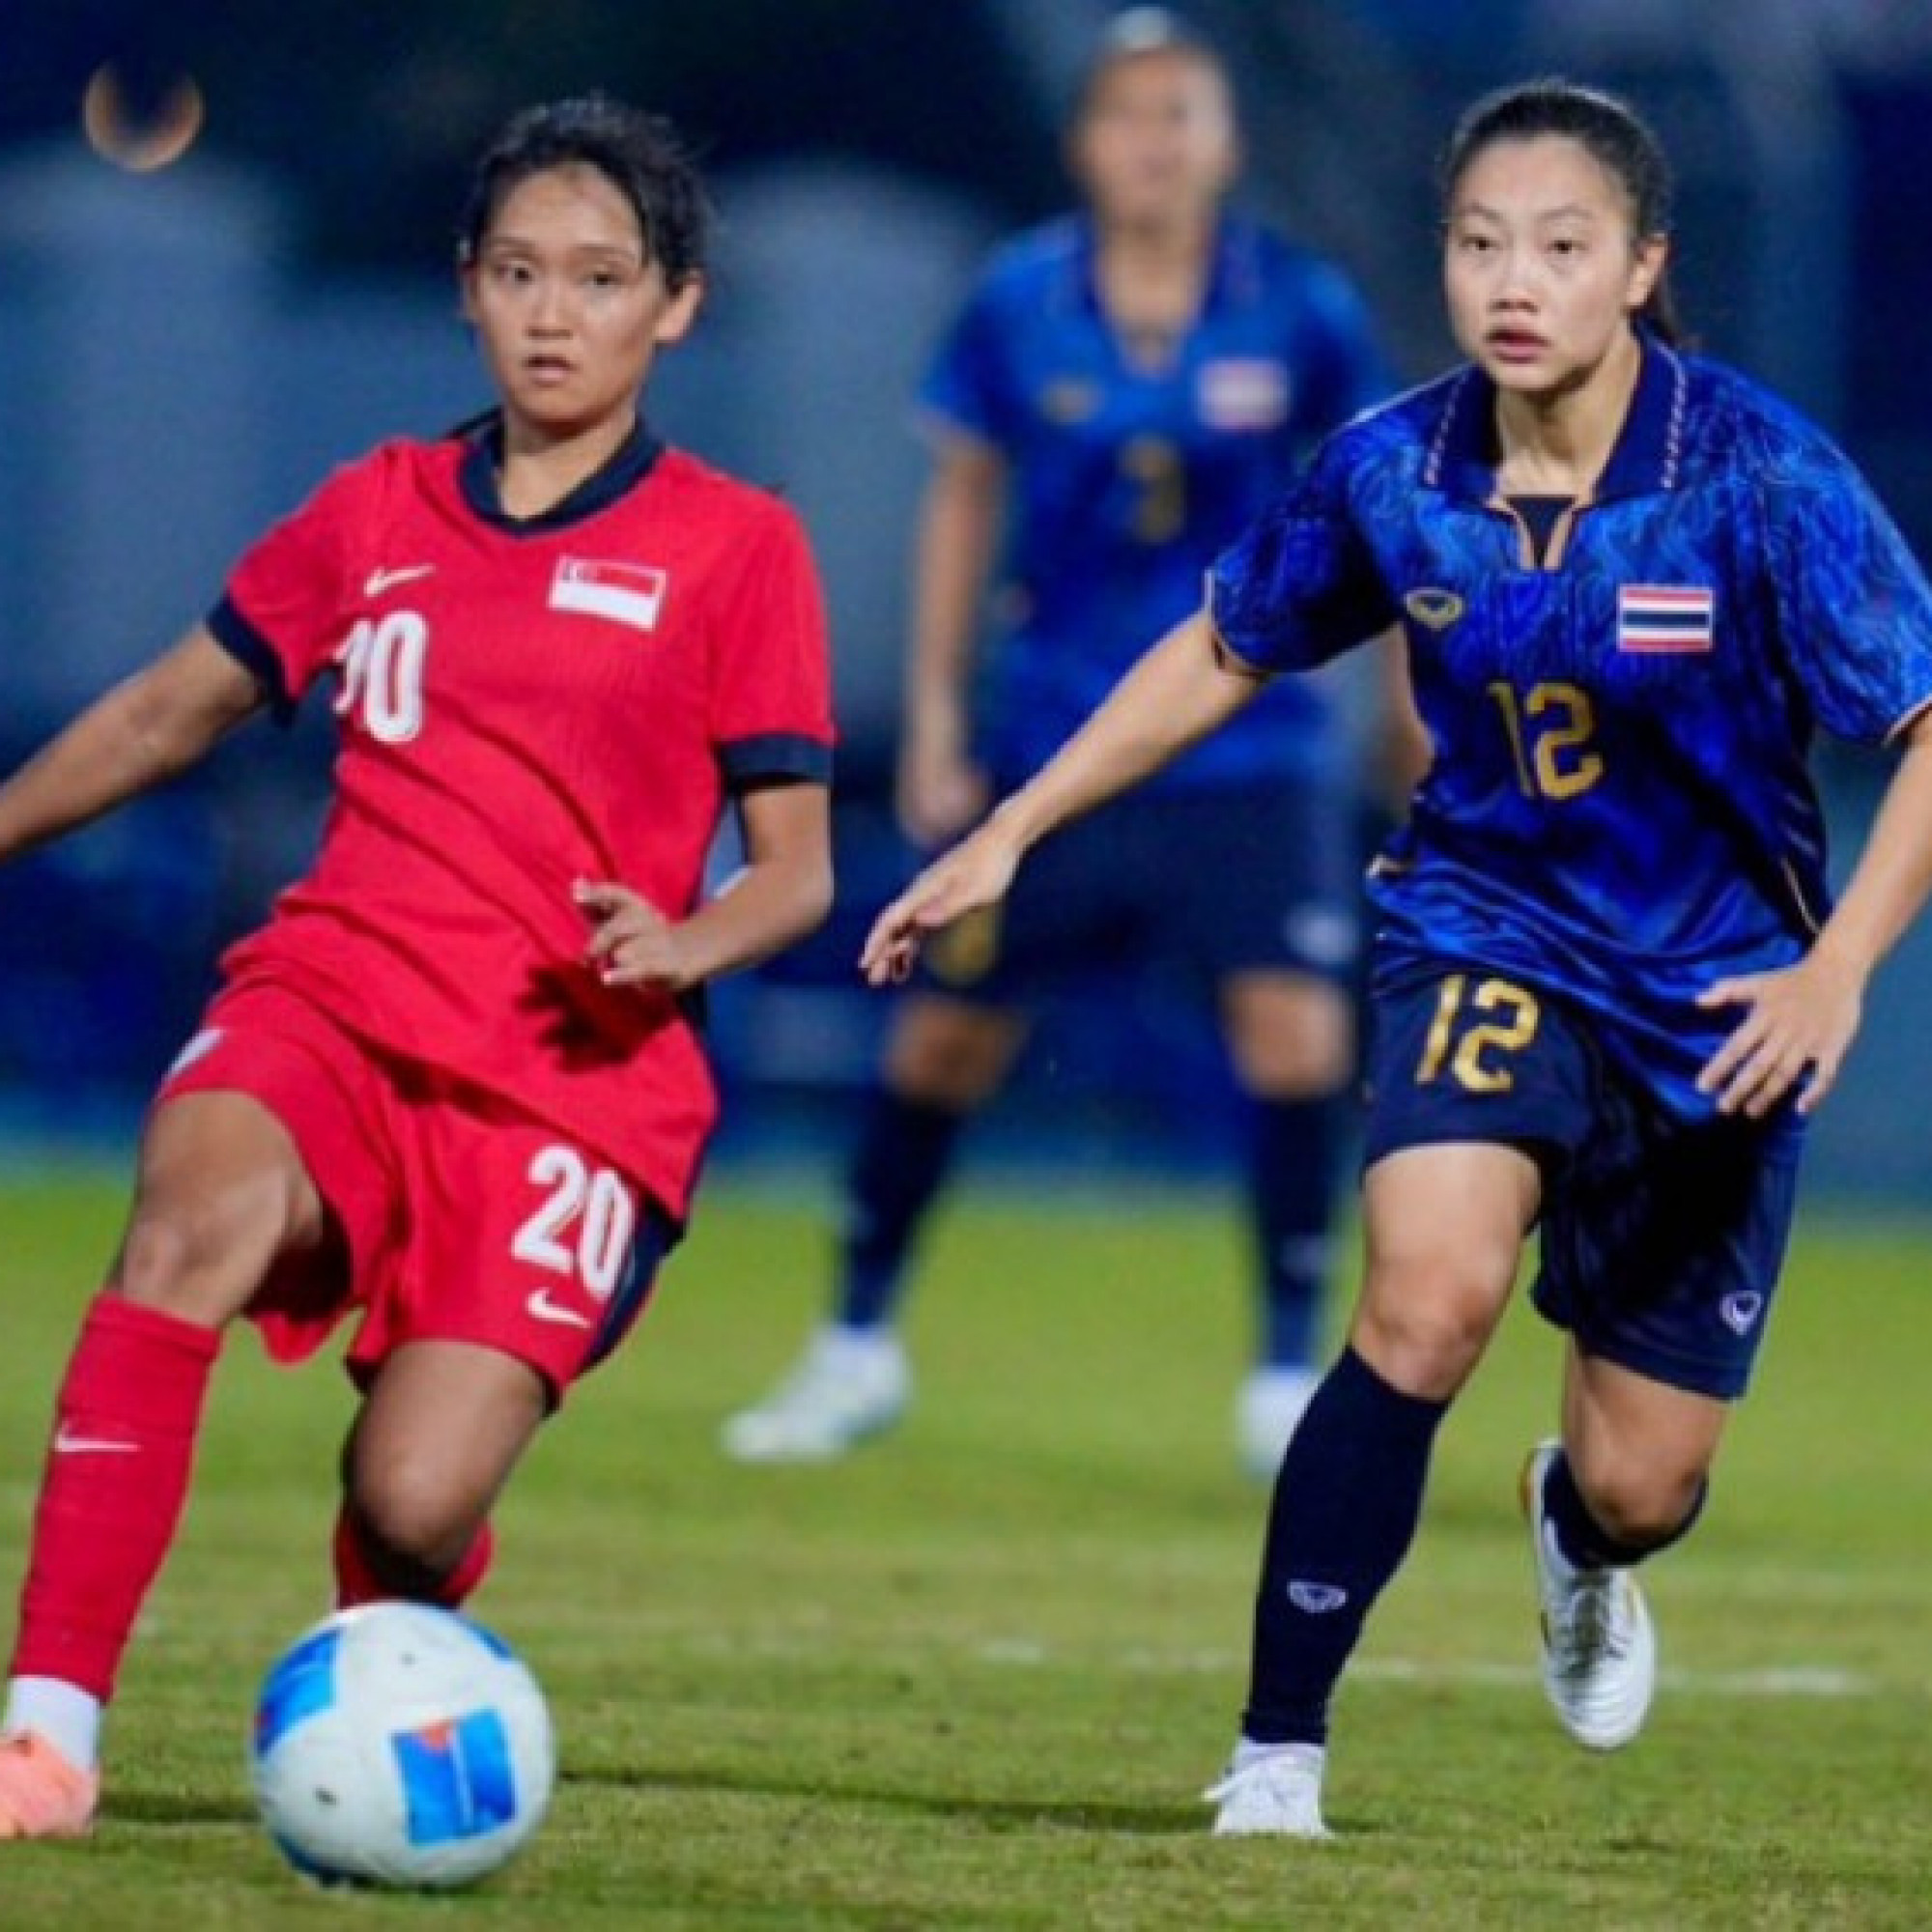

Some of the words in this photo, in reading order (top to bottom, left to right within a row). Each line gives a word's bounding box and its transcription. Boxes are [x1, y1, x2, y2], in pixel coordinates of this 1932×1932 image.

[1487, 681, 1604, 800] 12
[1414, 974, 1540, 1094] 12
[511, 1144, 634, 1300] 20
